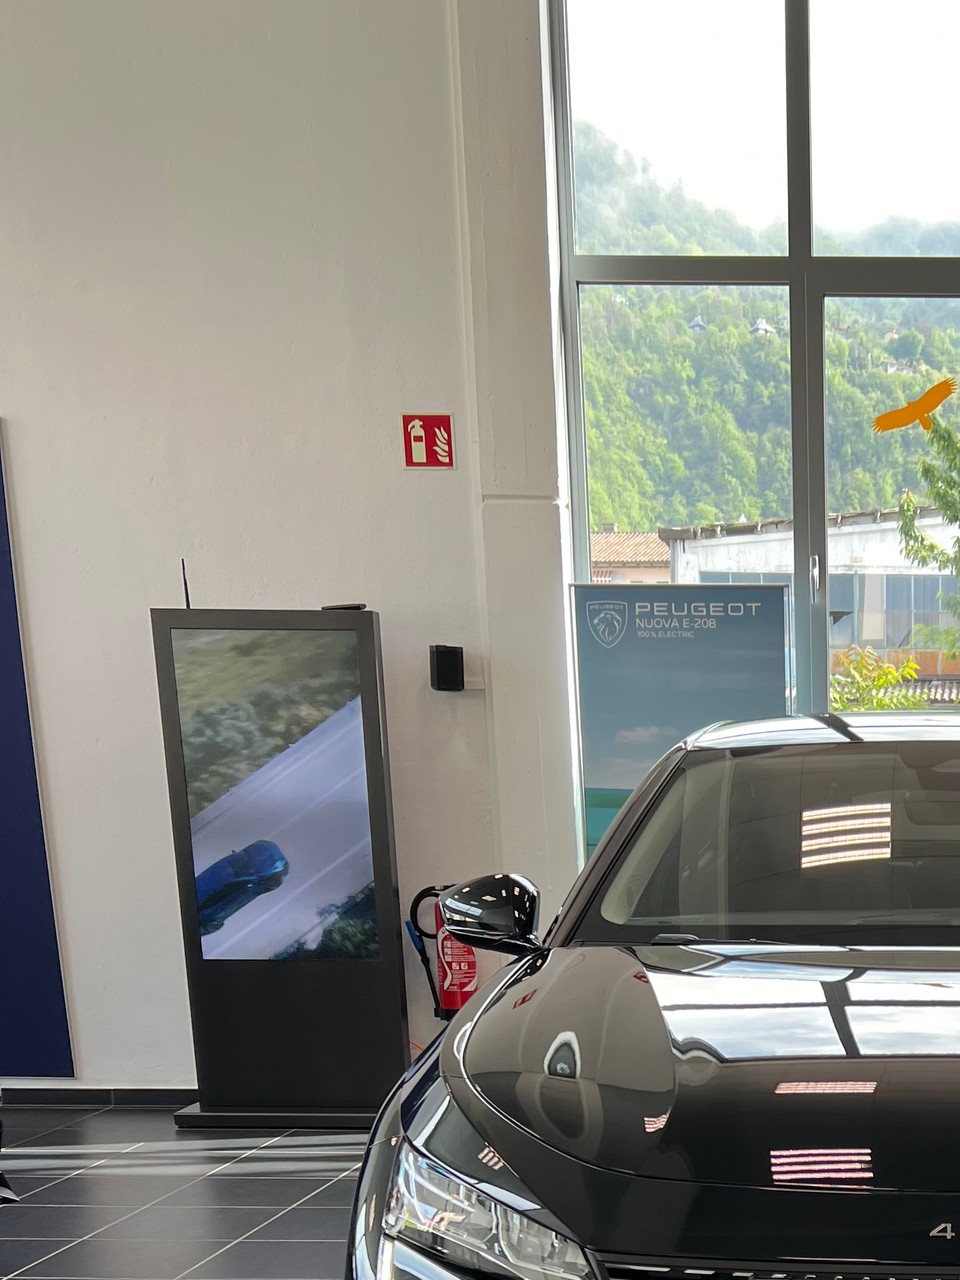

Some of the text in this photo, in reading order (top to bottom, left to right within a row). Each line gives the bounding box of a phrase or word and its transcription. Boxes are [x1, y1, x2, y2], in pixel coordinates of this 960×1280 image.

[635, 602, 761, 616] PEUGEOT
[635, 618, 717, 629] NUOVA E-208
[658, 630, 695, 638] ELECTRIC
